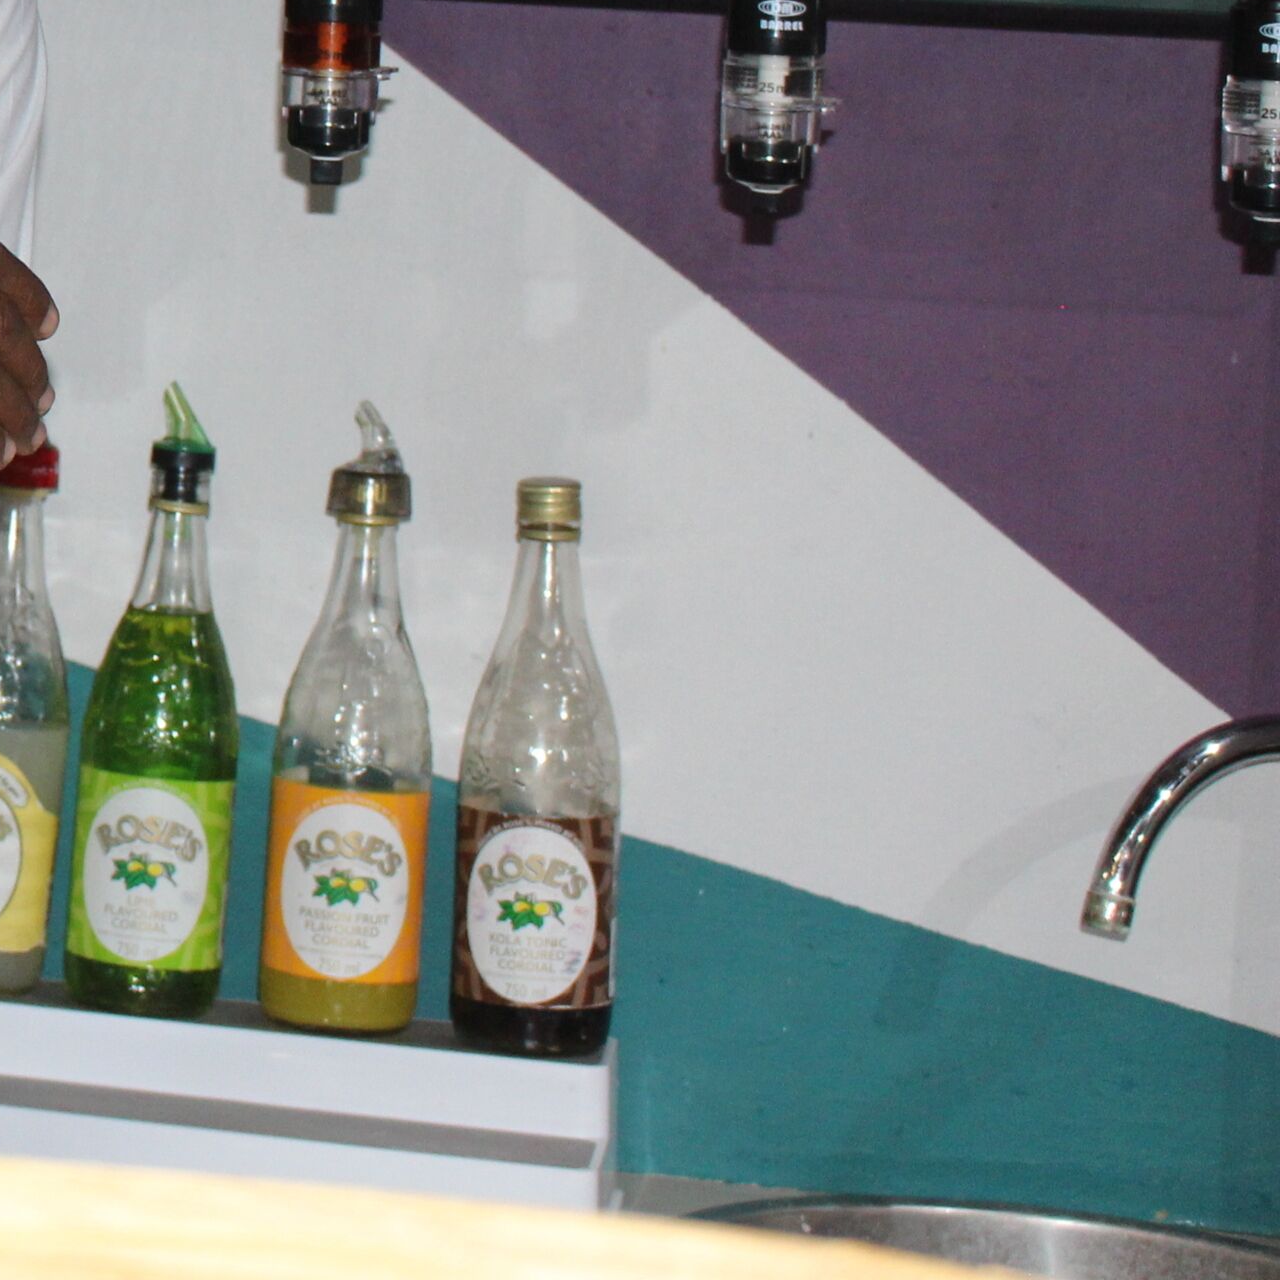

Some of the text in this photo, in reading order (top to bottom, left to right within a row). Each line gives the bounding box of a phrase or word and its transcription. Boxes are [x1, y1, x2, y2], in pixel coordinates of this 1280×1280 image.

[759, 18, 804, 32] BARREL
[96, 814, 204, 863] ROSE'S
[294, 829, 403, 877] ROSE'S
[477, 851, 588, 900] ROSE'S
[355, 912, 390, 926] FRUIT
[303, 919, 381, 939] FLAVOURED
[488, 932, 569, 950] KOLA TONIC
[488, 945, 566, 961] FLAVOURED
[496, 959, 557, 974] CORDIAL
[504, 981, 527, 997] 750
